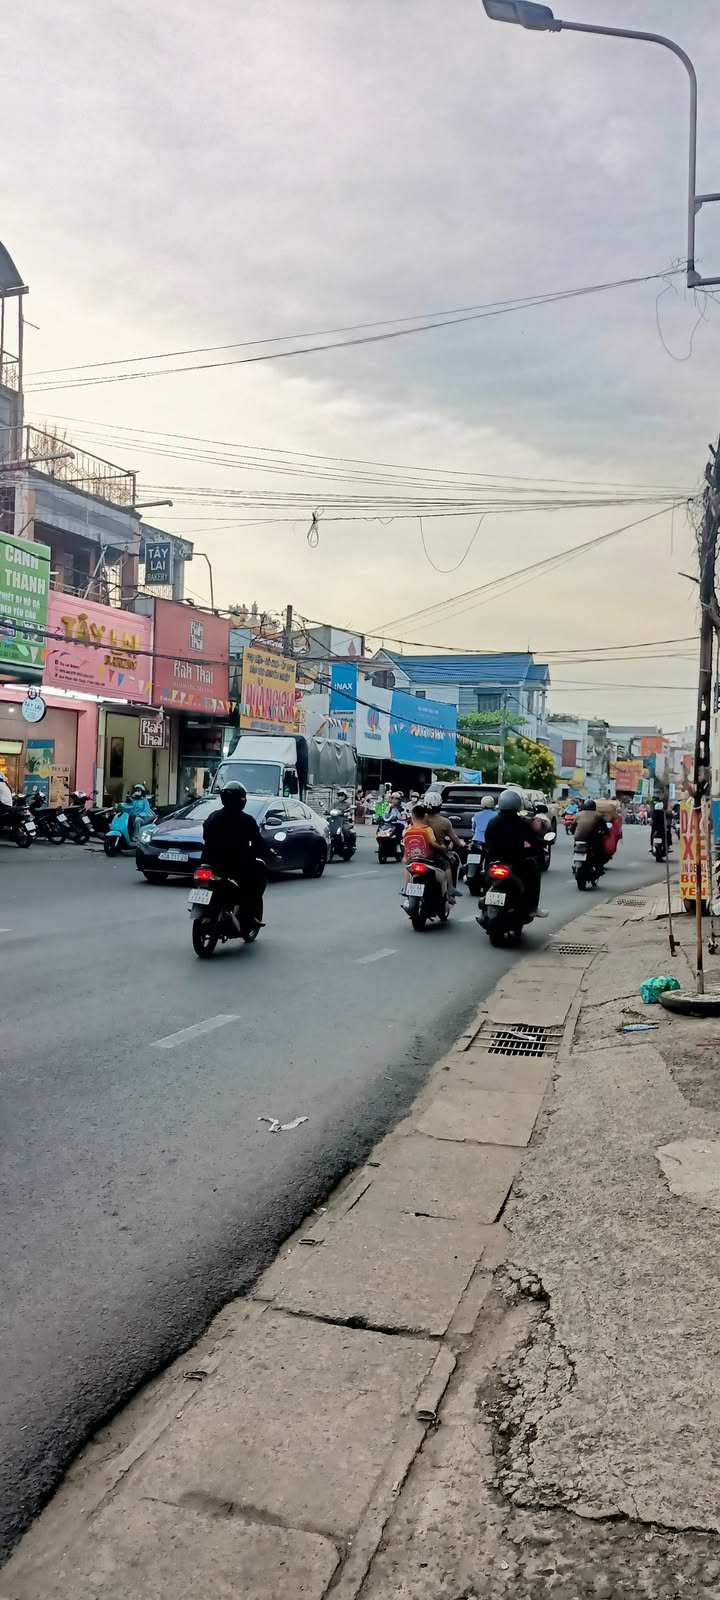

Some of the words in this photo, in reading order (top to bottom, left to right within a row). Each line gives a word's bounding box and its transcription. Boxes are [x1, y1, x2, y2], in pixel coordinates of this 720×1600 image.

[148, 546, 169, 560] TÂY
[150, 560, 166, 571] LAI
[147, 573, 168, 582] BAKERY
[61, 613, 106, 649] TÂY
